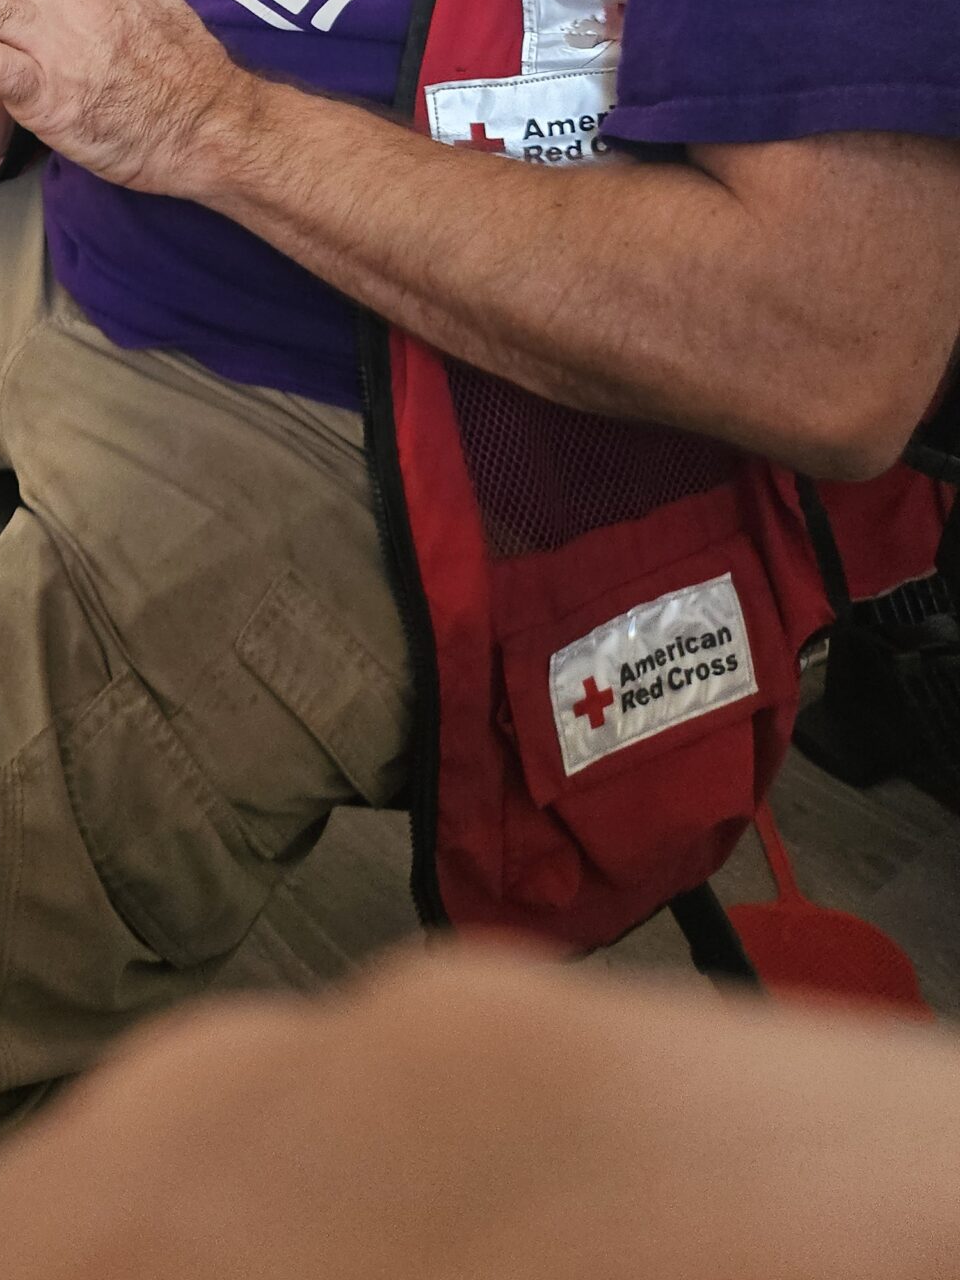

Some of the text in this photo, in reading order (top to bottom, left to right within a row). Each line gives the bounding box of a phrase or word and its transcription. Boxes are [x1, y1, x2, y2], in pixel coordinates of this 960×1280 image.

[523, 105, 615, 140] Amer
[523, 139, 583, 164] Red
[619, 625, 733, 687] American
[621, 653, 739, 714] Red Cross
